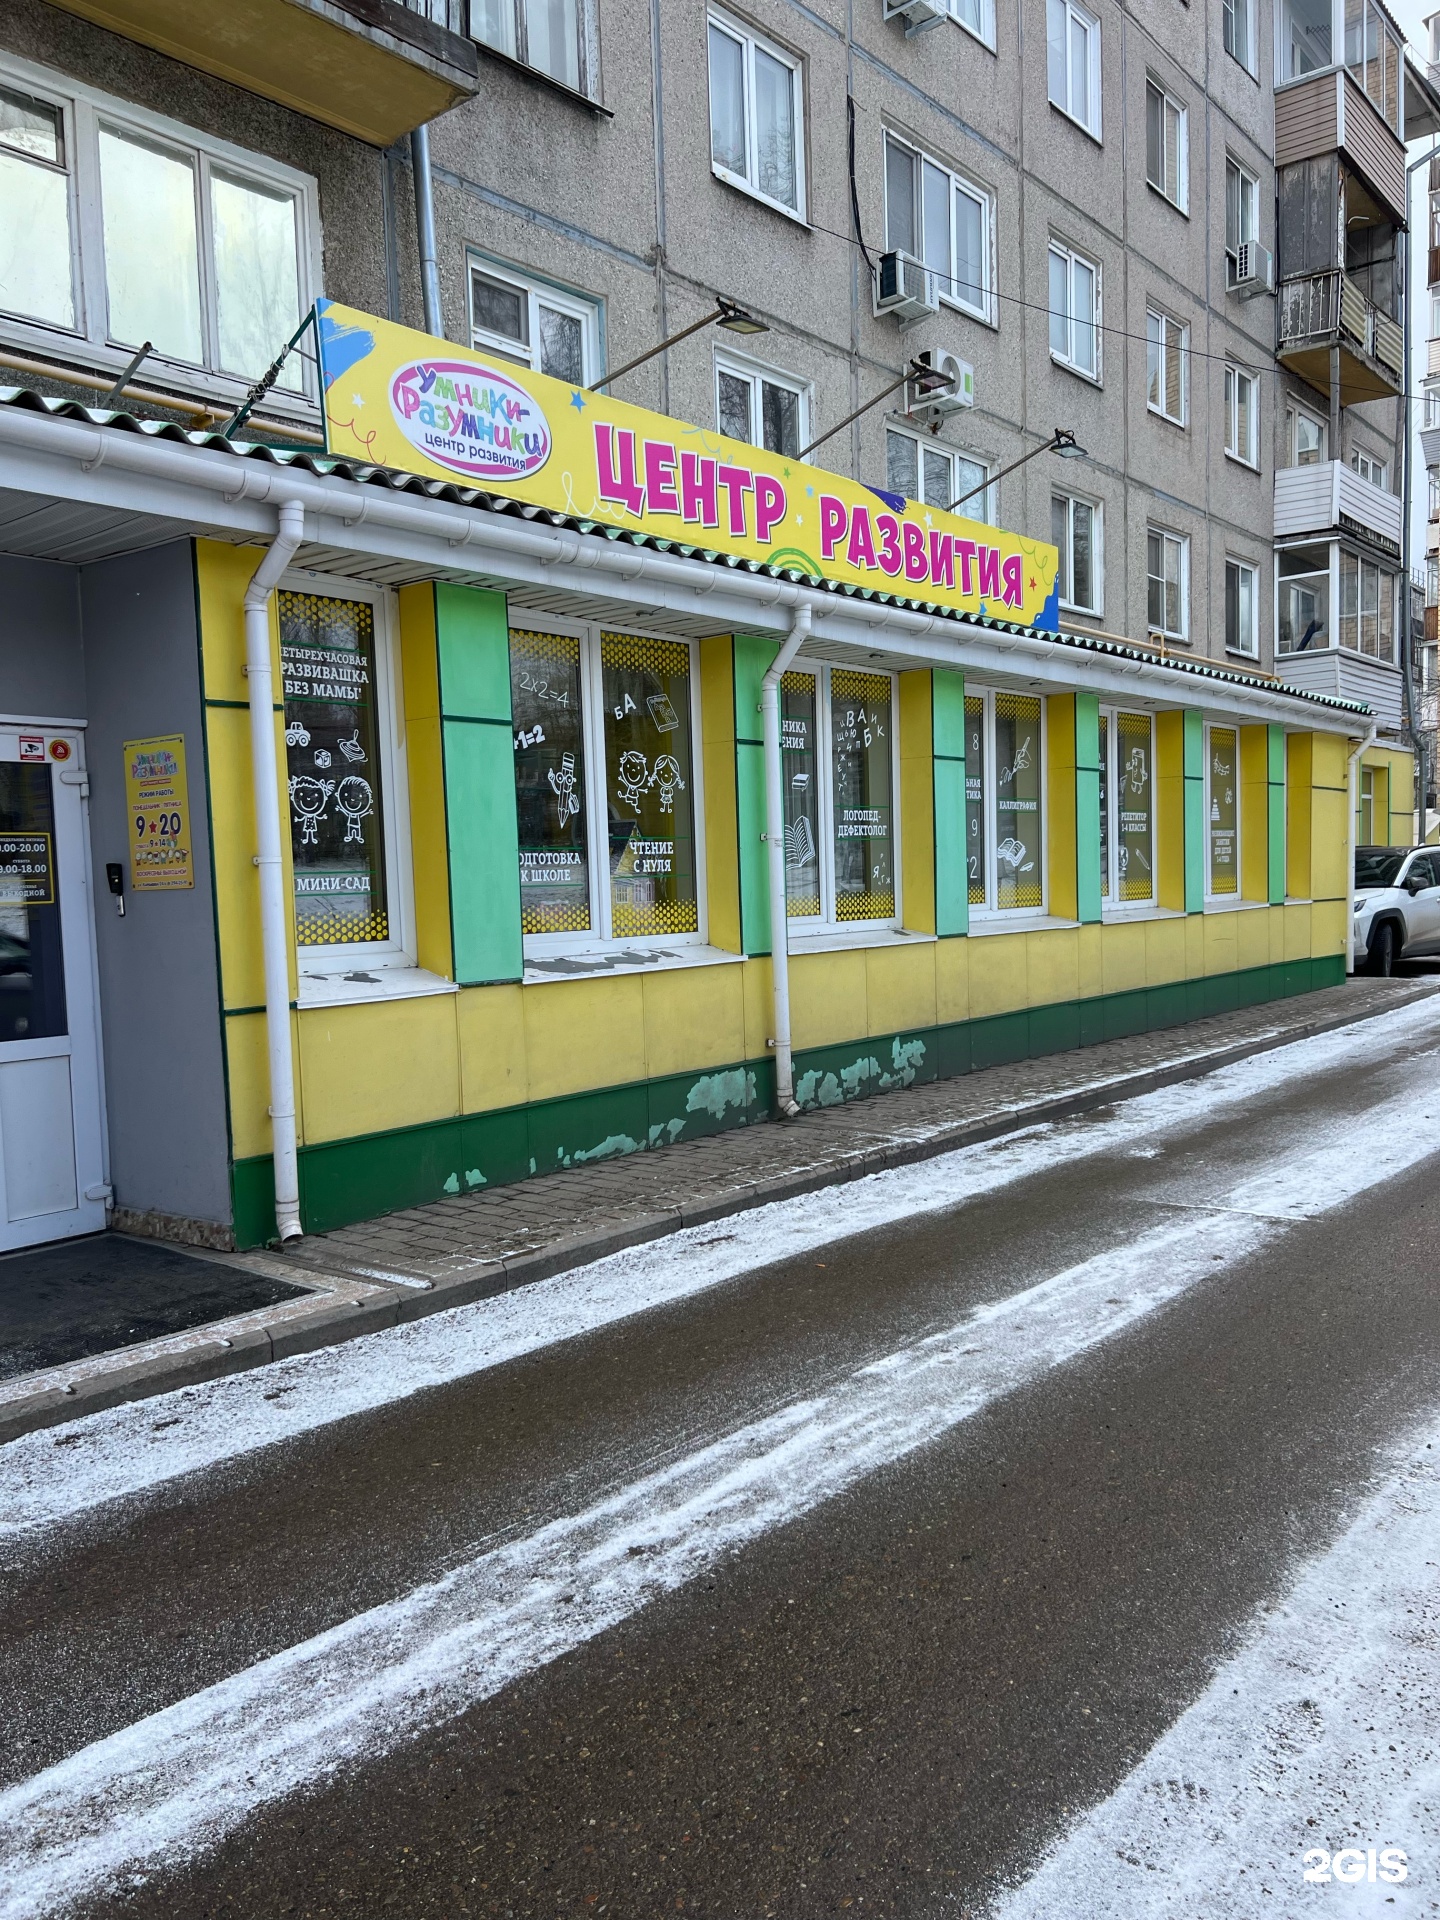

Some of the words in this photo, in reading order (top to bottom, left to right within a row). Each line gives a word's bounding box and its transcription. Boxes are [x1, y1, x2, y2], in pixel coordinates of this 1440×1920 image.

[425, 432, 465, 455] центр
[469, 445, 526, 471] развития
[593, 421, 787, 543] ЦЕНТР
[818, 494, 1024, 609] РАЗВИТИЯ
[281, 662, 369, 684] РАЗВИВАШКА
[285, 680, 309, 695] БЕЗ
[782, 719, 807, 734] НИКА
[973, 734, 979, 751] 8
[843, 810, 881, 823] ЛОГОПЕД-
[136, 815, 146, 837] 9
[160, 812, 182, 836] 20
[838, 825, 887, 838] ДЕФЕКТОЛОГ
[0, 843, 46, 853] .00-20.00
[630, 841, 674, 855] ЧТЕНИЕ
[642, 859, 672, 873] НУЛЯ
[521, 870, 529, 882] К
[531, 869, 571, 882] ШКОЛЕ
[296, 876, 371, 891] МИНИ-САД
